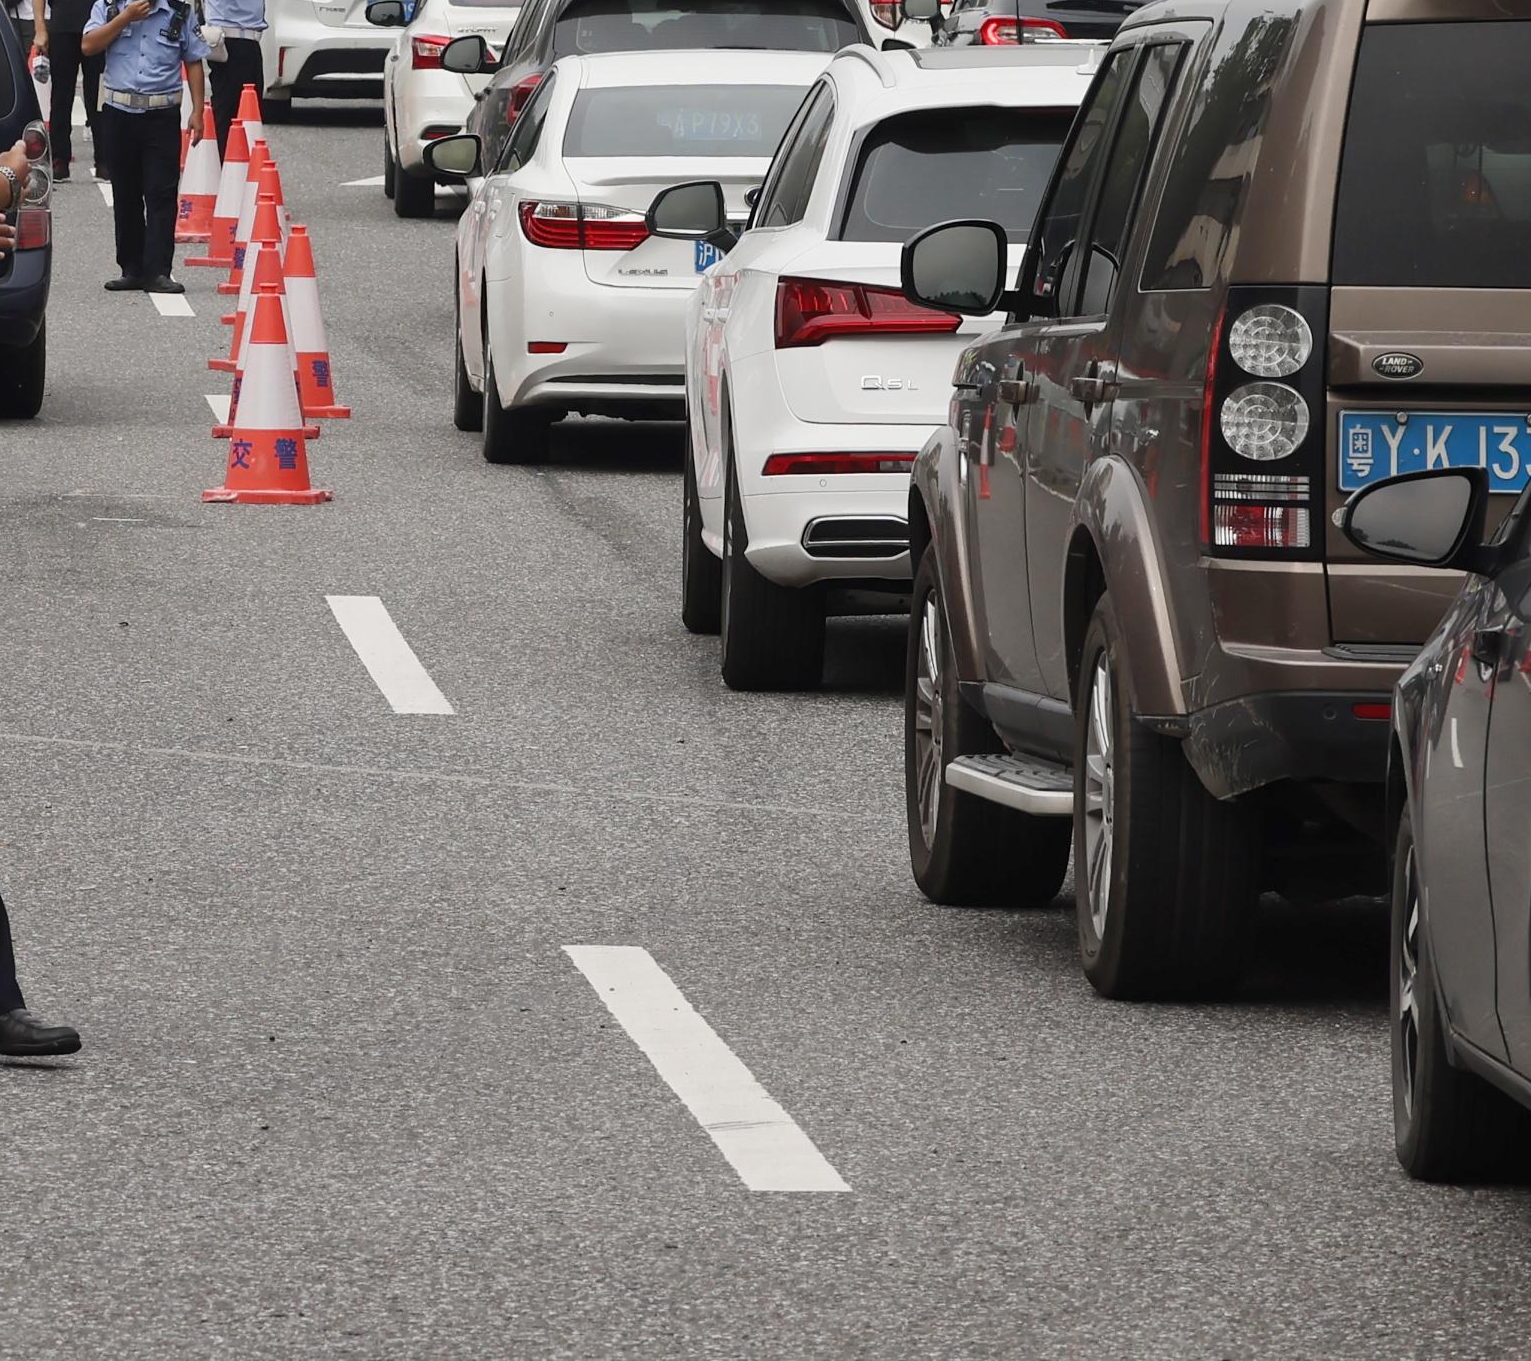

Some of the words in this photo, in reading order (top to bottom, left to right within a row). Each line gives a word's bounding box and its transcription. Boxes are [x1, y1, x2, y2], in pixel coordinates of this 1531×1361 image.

[1382, 357, 1407, 365] LAND
[1384, 365, 1415, 374] ROVER
[231, 439, 252, 470] 交
[274, 438, 298, 470] 警
